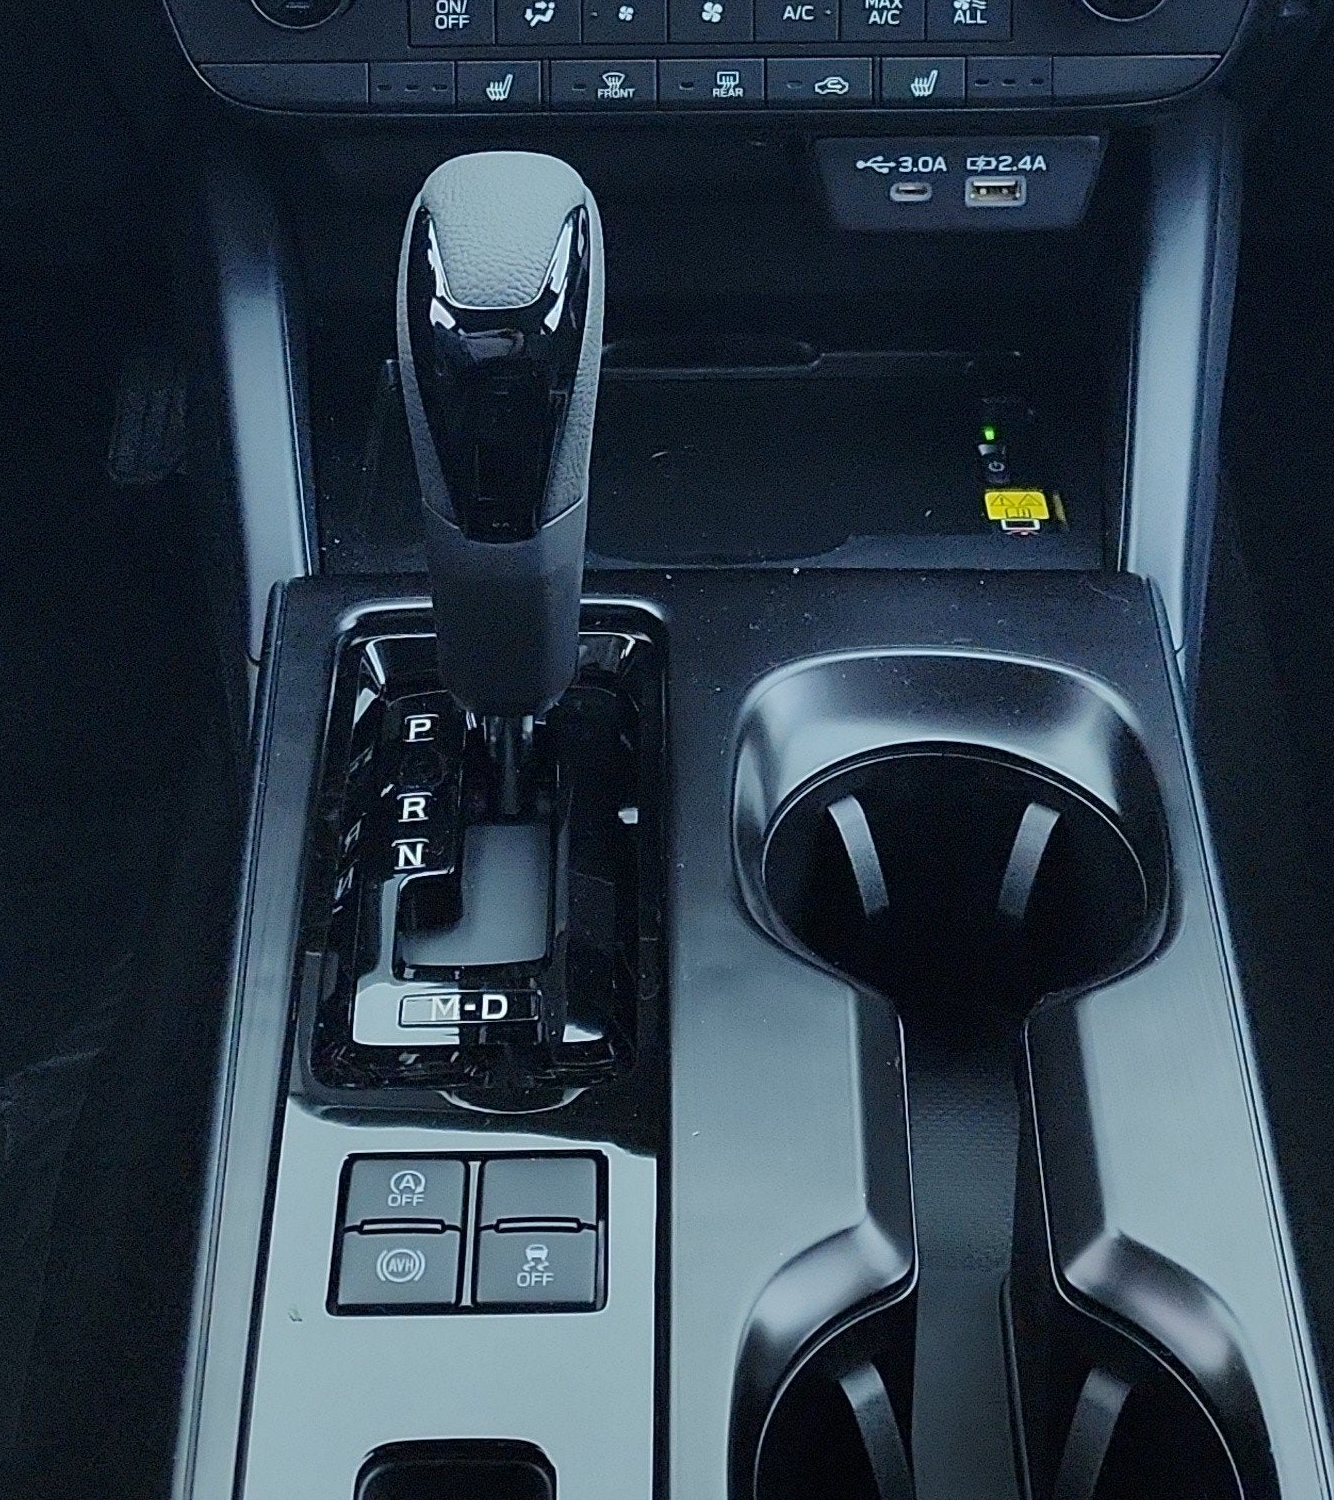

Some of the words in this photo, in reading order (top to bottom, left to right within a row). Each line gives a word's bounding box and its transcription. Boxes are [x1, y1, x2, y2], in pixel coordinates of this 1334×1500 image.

[782, 4, 815, 21] A/C
[868, 9, 900, 25] A/C
[953, 9, 987, 24] ALL
[434, 14, 470, 30] OFF
[597, 88, 636, 100] FRONT
[712, 87, 744, 99] REAR
[897, 156, 948, 173] 3.0A
[998, 155, 1047, 172] 2.4A
[408, 718, 432, 741] P
[401, 796, 427, 820] R
[398, 843, 424, 867] N
[387, 1193, 424, 1207] OFF
[388, 1257, 415, 1273] AVH
[517, 1272, 554, 1287] OFF
